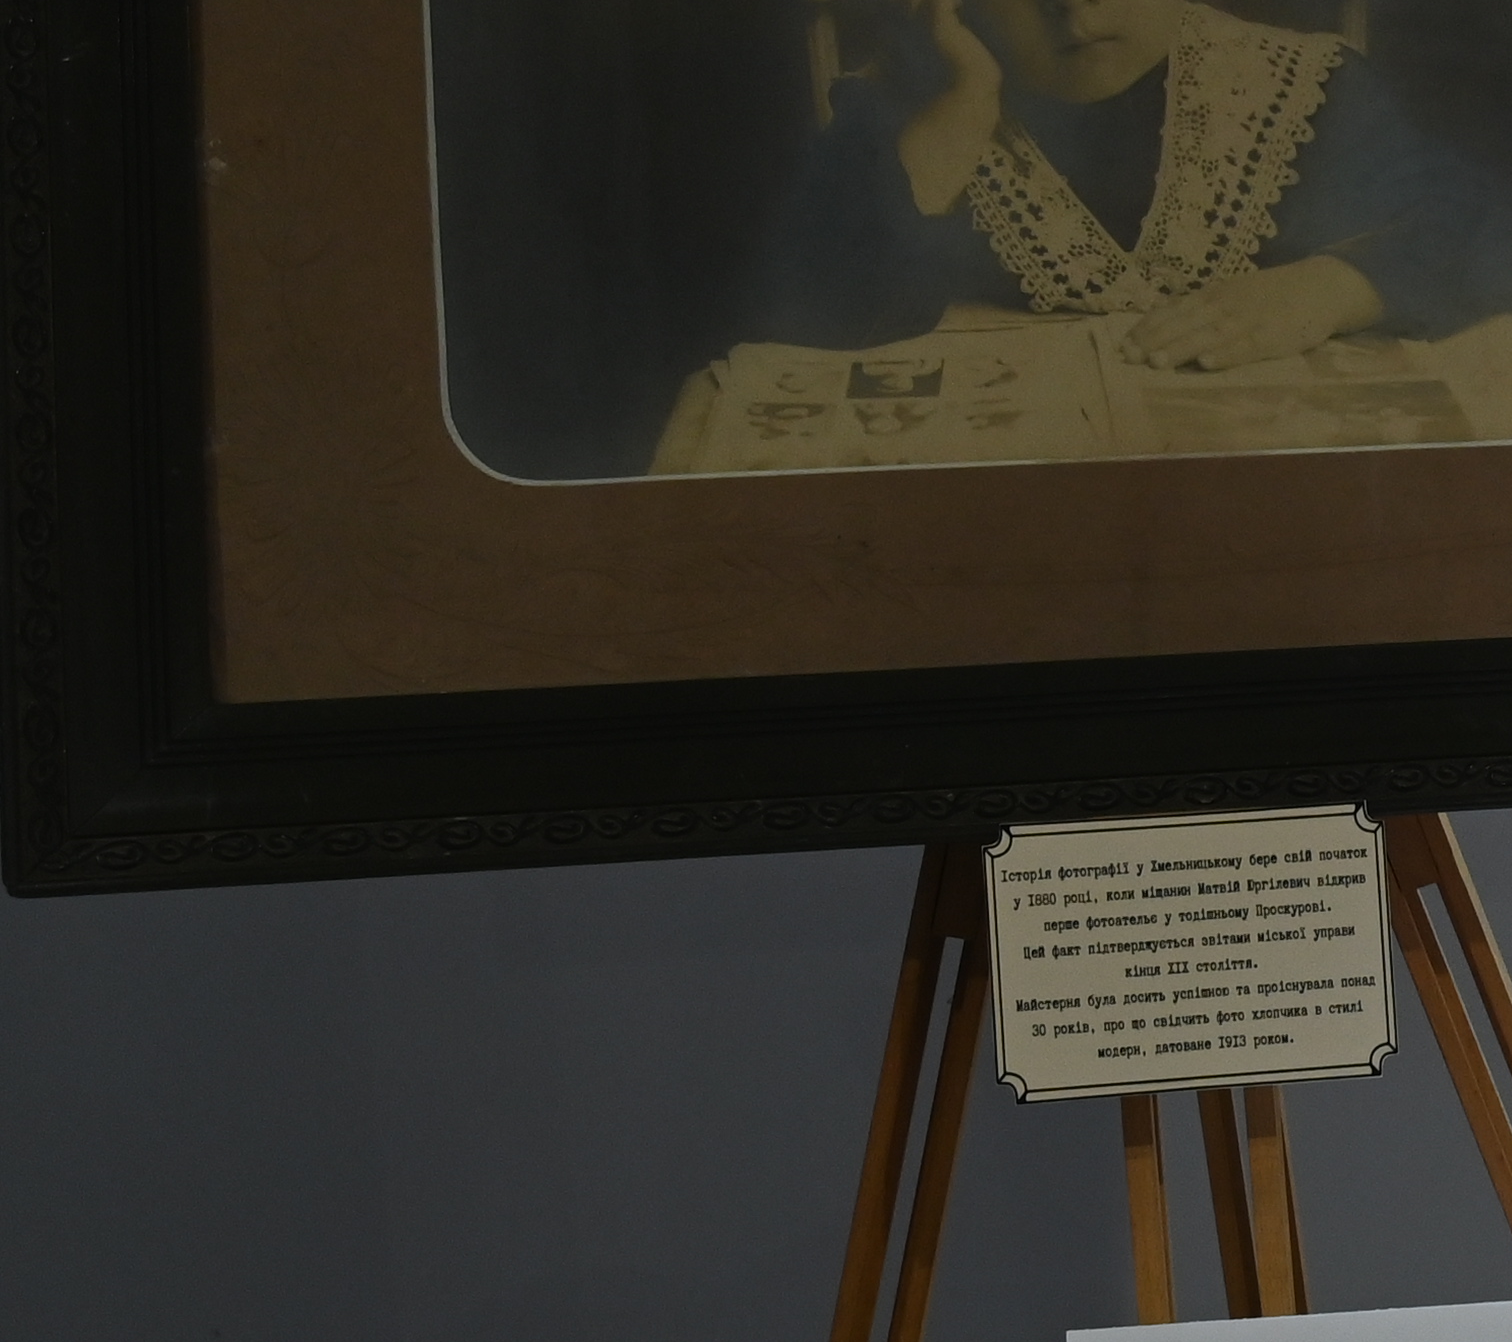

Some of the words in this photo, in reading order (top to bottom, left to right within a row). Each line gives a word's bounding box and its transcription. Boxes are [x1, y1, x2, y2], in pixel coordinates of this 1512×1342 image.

[1001, 867, 1052, 884] Історія
[1057, 861, 1130, 881] фотографії
[1136, 863, 1144, 877] у
[1150, 856, 1242, 872] Хмельницькому
[1248, 853, 1278, 868] бере
[1283, 849, 1312, 863] свій
[1318, 848, 1368, 861] початок
[1013, 897, 1021, 911] у
[1027, 892, 1057, 907] 1880
[1063, 890, 1098, 908] році,
[1106, 889, 1135, 902] коли
[1141, 885, 1191, 899] міщанин
[1197, 879, 1240, 895] Матвій
[1246, 877, 1310, 895] Юргілевич
[1316, 873, 1366, 888] відкрив
[1043, 919, 1080, 934] перше
[1085, 914, 1158, 931] фотоательє
[1164, 913, 1172, 927] у
[1177, 907, 1249, 922] тодішньому
[1255, 899, 1332, 920] Проскурові.
[1124, 964, 1161, 978] кінця
[1167, 960, 1190, 975] XIX
[1195, 957, 1258, 972] століття.
[1097, 1045, 1146, 1059] модерн,
[1154, 1039, 1212, 1055] датоване
[1217, 1034, 1247, 1049] 1913
[1253, 1033, 1294, 1049] роком.
